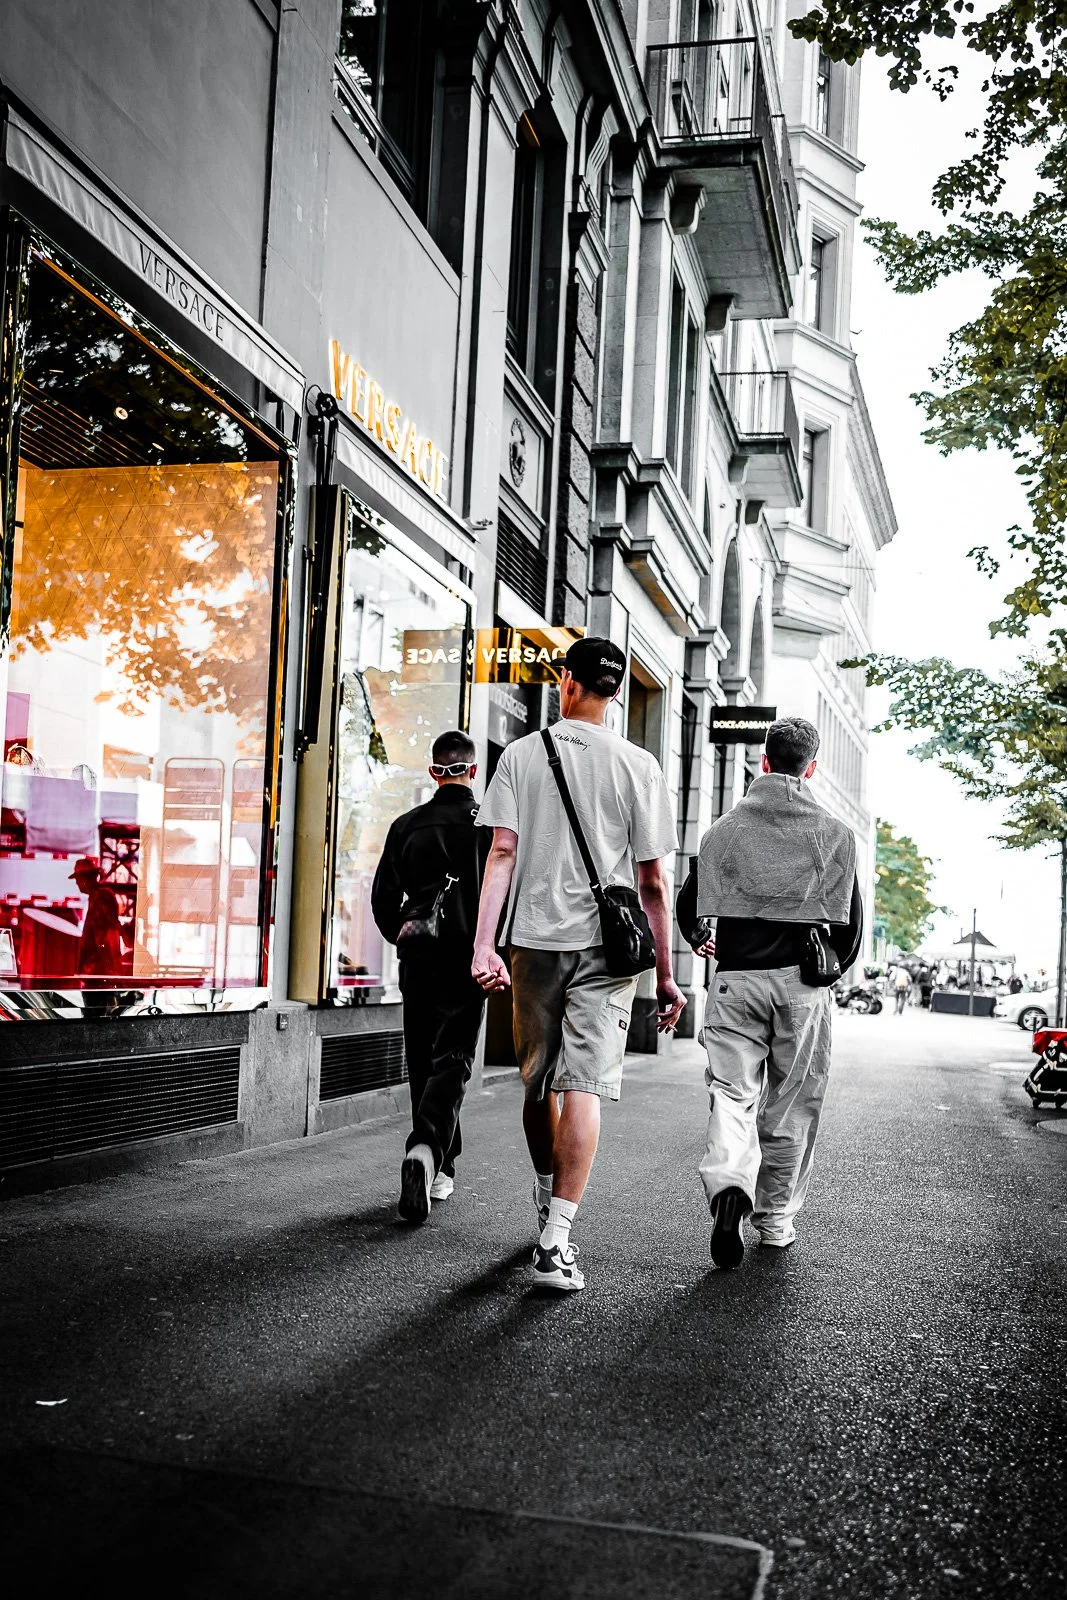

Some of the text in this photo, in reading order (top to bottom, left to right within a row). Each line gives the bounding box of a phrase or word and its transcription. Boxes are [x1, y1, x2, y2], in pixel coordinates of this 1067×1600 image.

[140, 243, 224, 341] VERSACE
[329, 339, 449, 503] VERSACE
[482, 647, 567, 664] VERSAC
